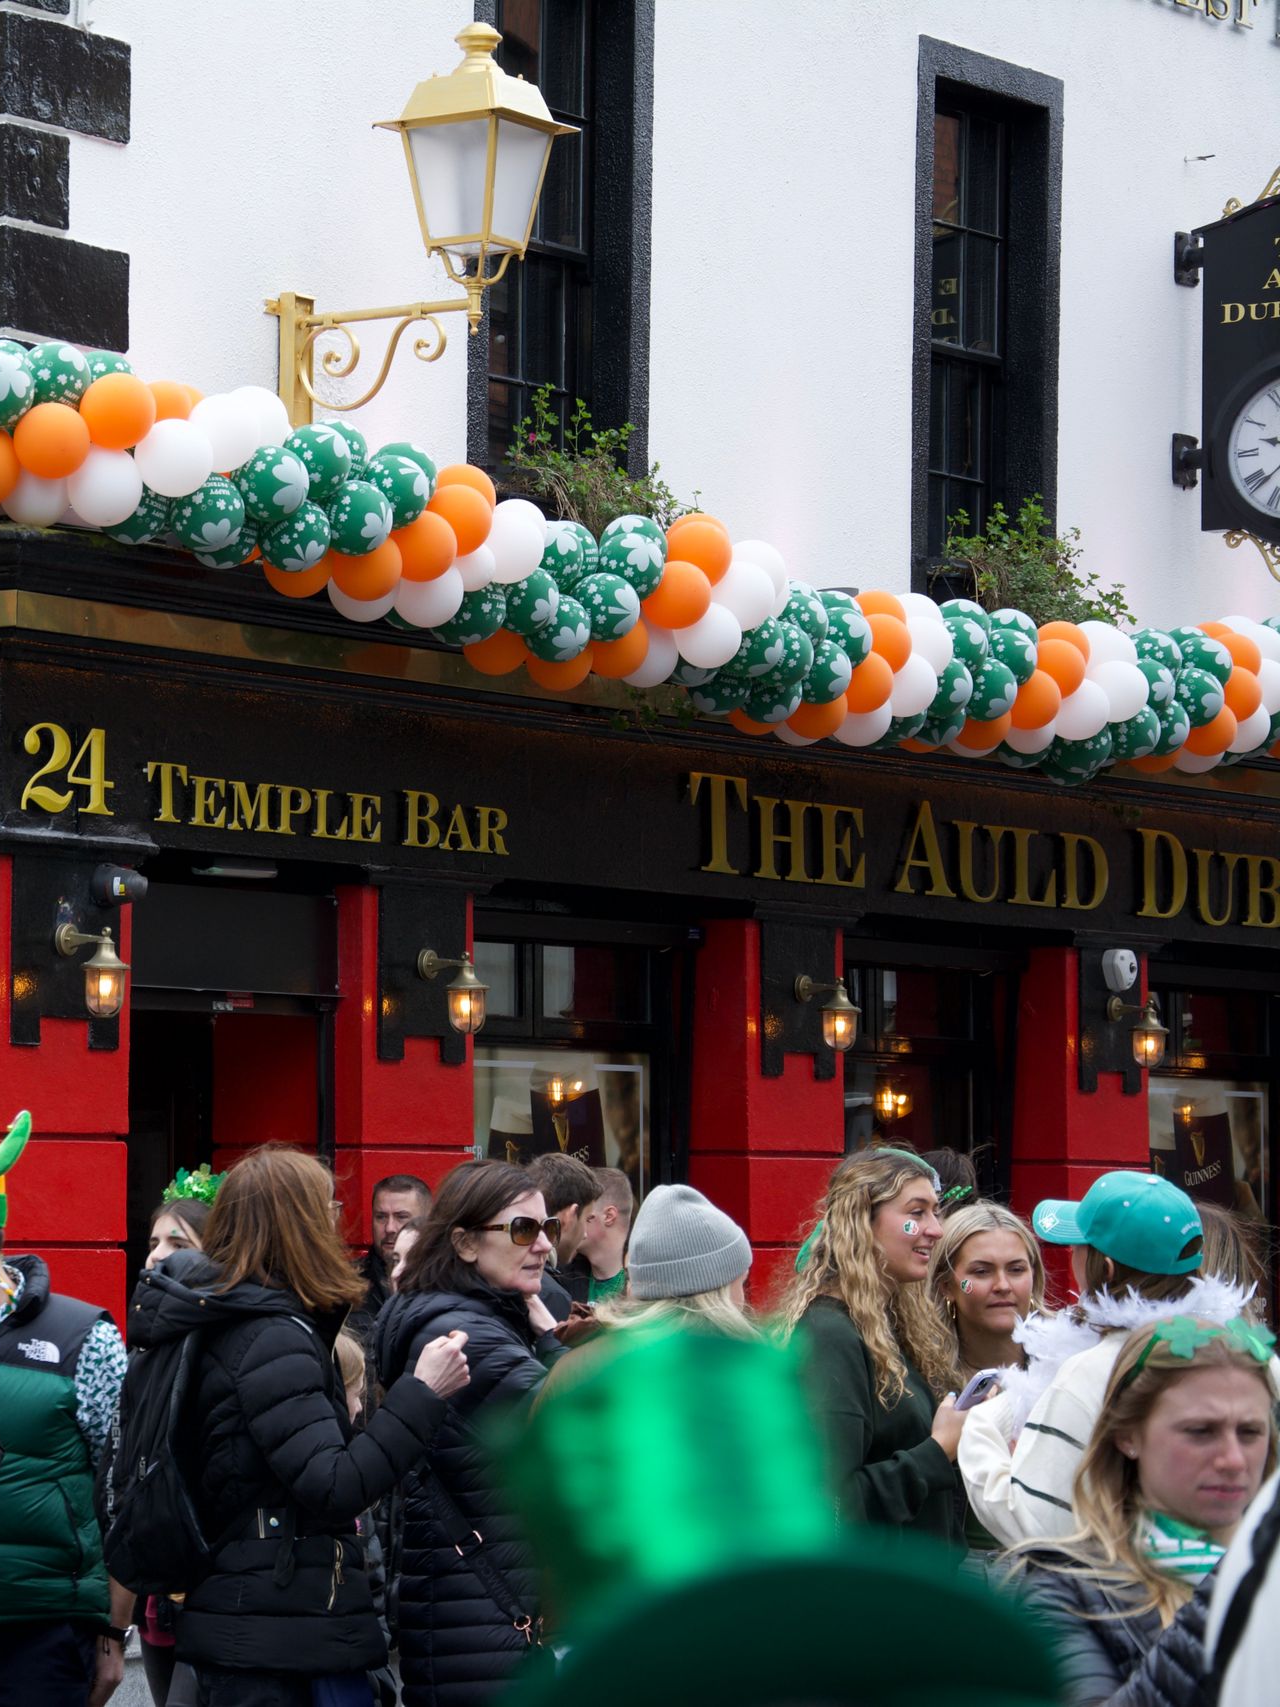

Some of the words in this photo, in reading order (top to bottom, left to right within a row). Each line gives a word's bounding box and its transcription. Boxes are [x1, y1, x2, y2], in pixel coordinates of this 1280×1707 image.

[209, 488, 231, 496] HAPPY
[20, 722, 115, 817] 24
[146, 761, 383, 843] TEMPLE
[402, 788, 510, 856] BAR
[689, 771, 867, 889] THE
[893, 799, 1110, 911] AULD
[1135, 826, 1280, 929] DUB
[1184, 1159, 1223, 1188] GUINNESS
